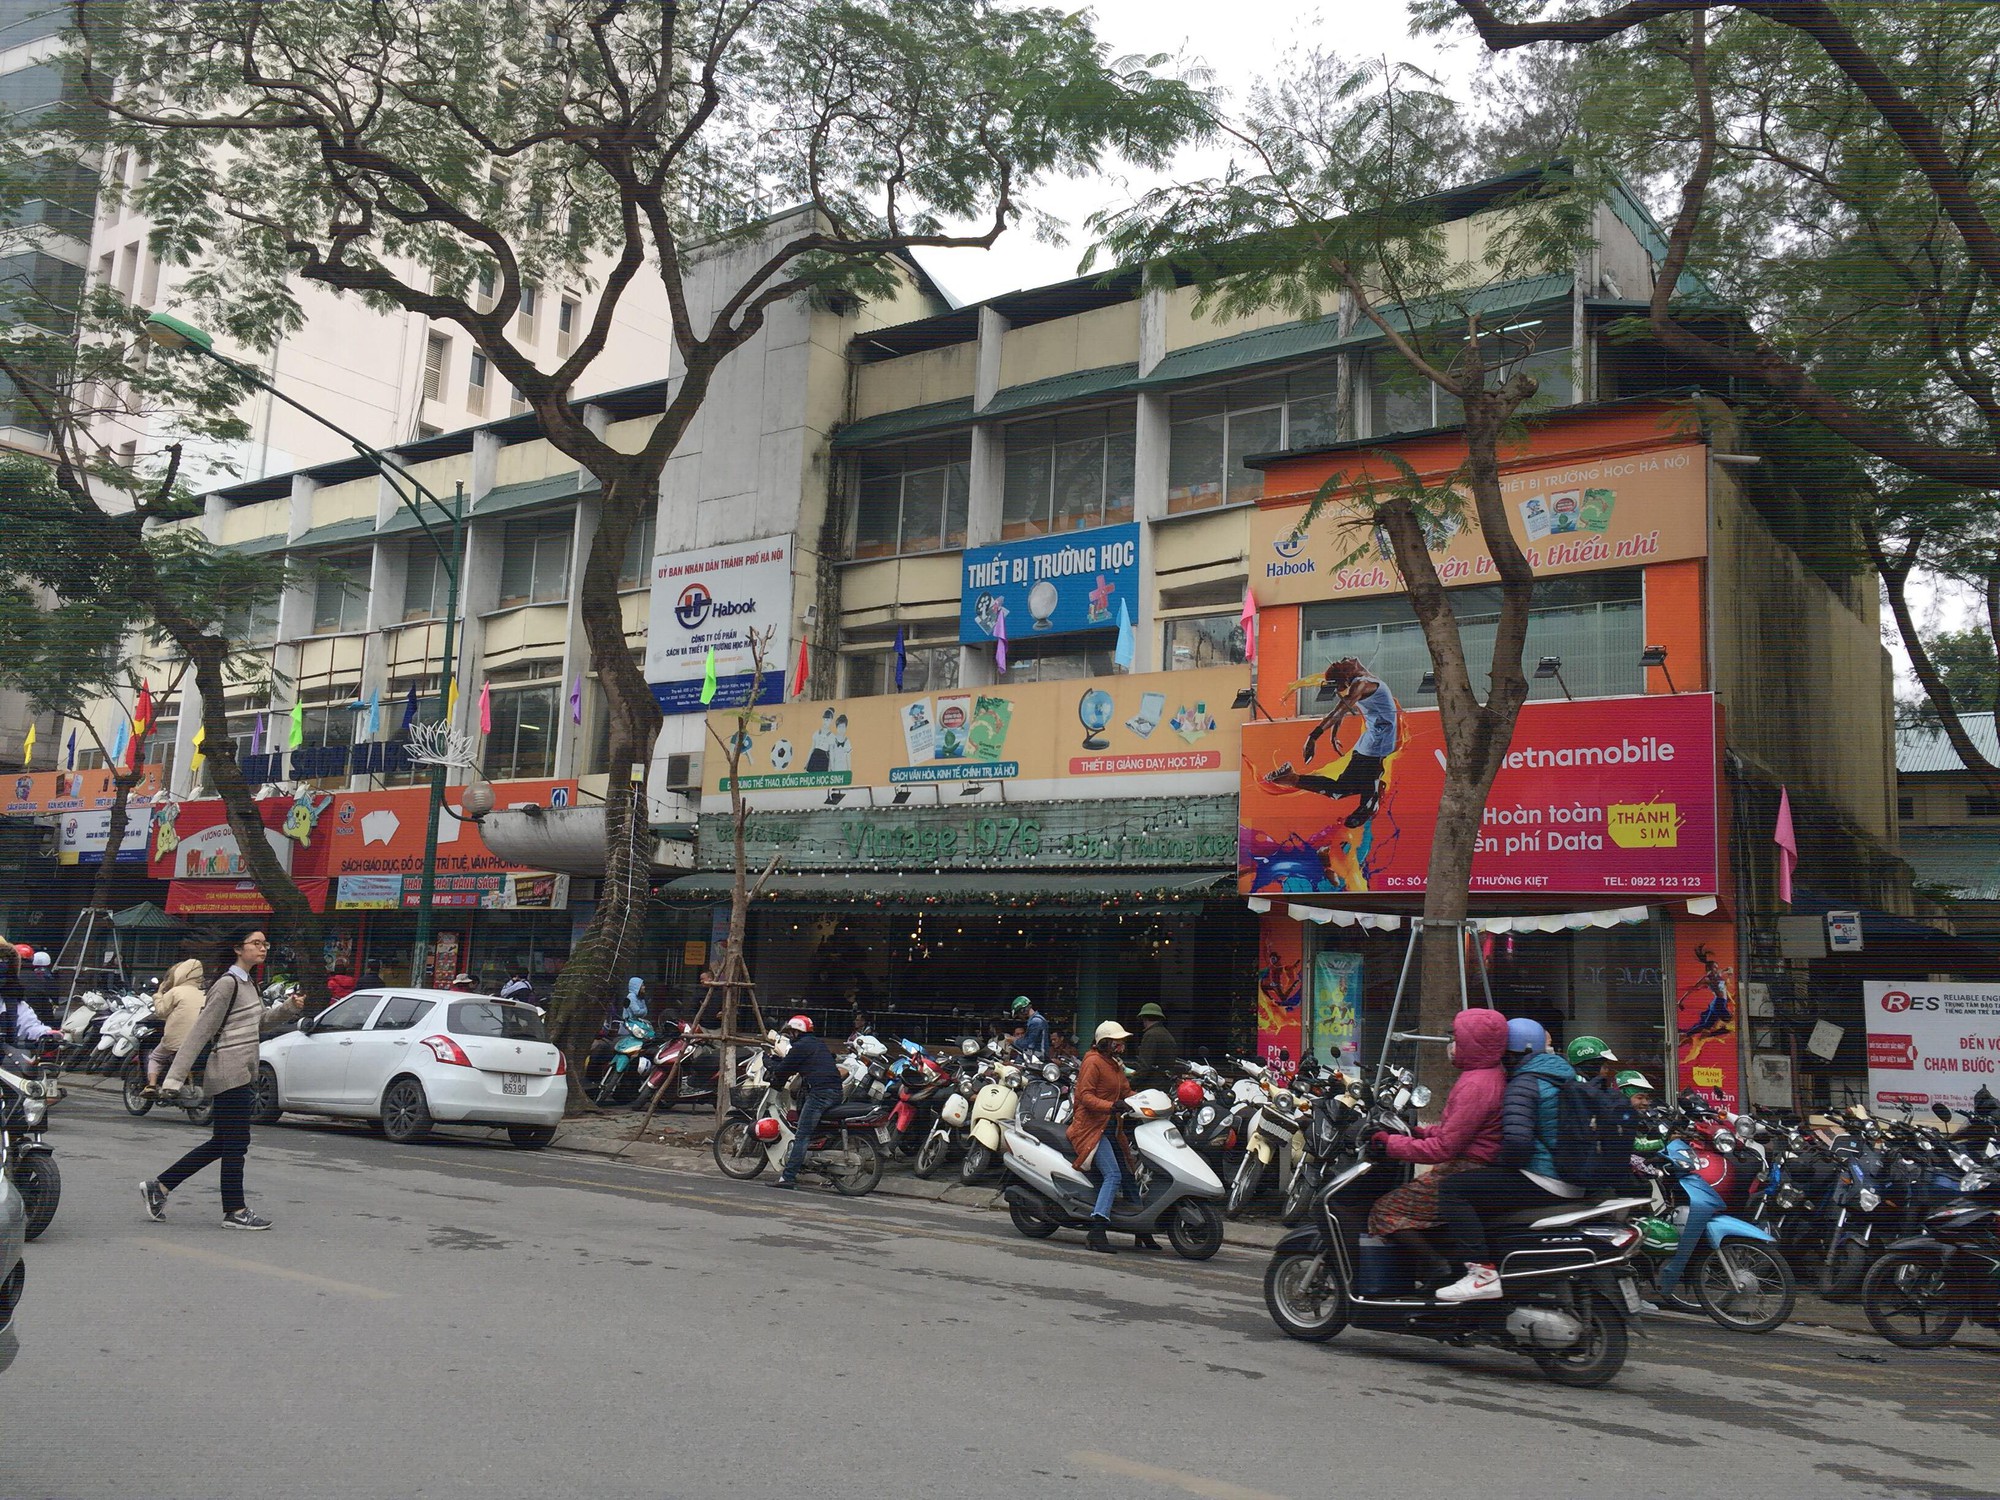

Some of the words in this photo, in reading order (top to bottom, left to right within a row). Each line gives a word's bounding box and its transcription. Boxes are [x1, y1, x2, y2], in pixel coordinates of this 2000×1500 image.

[1604, 463, 1635, 480] HỌC
[1664, 454, 1690, 469] NỘI
[669, 568, 683, 577] BAN
[684, 562, 704, 575] NHÂN
[705, 559, 719, 572] DÂN
[721, 556, 744, 569] THÀNH
[745, 550, 761, 566] PHỐ
[771, 548, 784, 563] NỘI
[968, 552, 1009, 589] THIẾT
[1013, 557, 1028, 587] BỊ
[1033, 544, 1095, 579] TRƯỜNG
[1101, 541, 1134, 574] HỌC
[1266, 558, 1315, 577] Habook
[1333, 567, 1390, 591] Sách,
[1547, 535, 1609, 567] thiếu
[1616, 530, 1659, 557] nhi
[711, 597, 756, 618] Habook
[706, 633, 713, 641] TY
[666, 647, 680, 657] SÁCH
[689, 643, 703, 654] THIẾT
[891, 769, 909, 782] SÁCH
[908, 769, 922, 781] VĂN
[937, 769, 952, 780] KINH
[962, 766, 981, 778] CHÍNH
[1003, 763, 1016, 778] HỘI
[1081, 757, 1105, 772] THIẾT
[1106, 760, 1115, 773] BỊ
[1116, 756, 1144, 770] GIẢNG
[1145, 758, 1167, 772] DẠY,
[1167, 756, 1188, 771] HỌC
[1189, 754, 1208, 769] TẬP
[764, 778, 781, 788] THAO,
[799, 776, 816, 787] PHỤC
[816, 776, 830, 786] HỌC
[830, 775, 844, 785] SINH
[1483, 802, 1542, 825] Hoàn
[1549, 801, 1602, 824] toàn
[1617, 804, 1670, 825] THÁNH
[841, 820, 959, 868] Vintage
[964, 817, 1042, 859] 1976
[1640, 827, 1670, 840] SIM
[1127, 835, 1195, 862] Thường
[1195, 834, 1237, 862] Kiệt
[1505, 830, 1542, 857] phí
[1548, 831, 1603, 851] Data
[341, 857, 362, 872] SÁCH
[363, 857, 382, 872] GIÁO
[383, 859, 400, 873] DỤC,
[436, 854, 450, 870] TRÍ
[471, 855, 488, 870] VĂN
[403, 876, 423, 891] THÁN
[452, 875, 477, 890] HÀNH
[477, 875, 501, 890] SÁCH
[1476, 875, 1522, 886] THƯỜNG
[1524, 876, 1549, 888] KIỆT
[1603, 876, 1628, 887] TEL:
[1630, 876, 1656, 887] 0922
[1659, 877, 1679, 887] 123
[1681, 877, 1701, 887] 123
[1886, 995, 1940, 1011] RES
[1943, 994, 1980, 1002] RELIABLE
[1960, 1033, 1985, 1050] ĐẾN
[1576, 1046, 1595, 1057] Grab
[1924, 1057, 1959, 1074] CHẠM
[1962, 1056, 1995, 1073] BƯỚC
[509, 1073, 522, 1084] 30A
